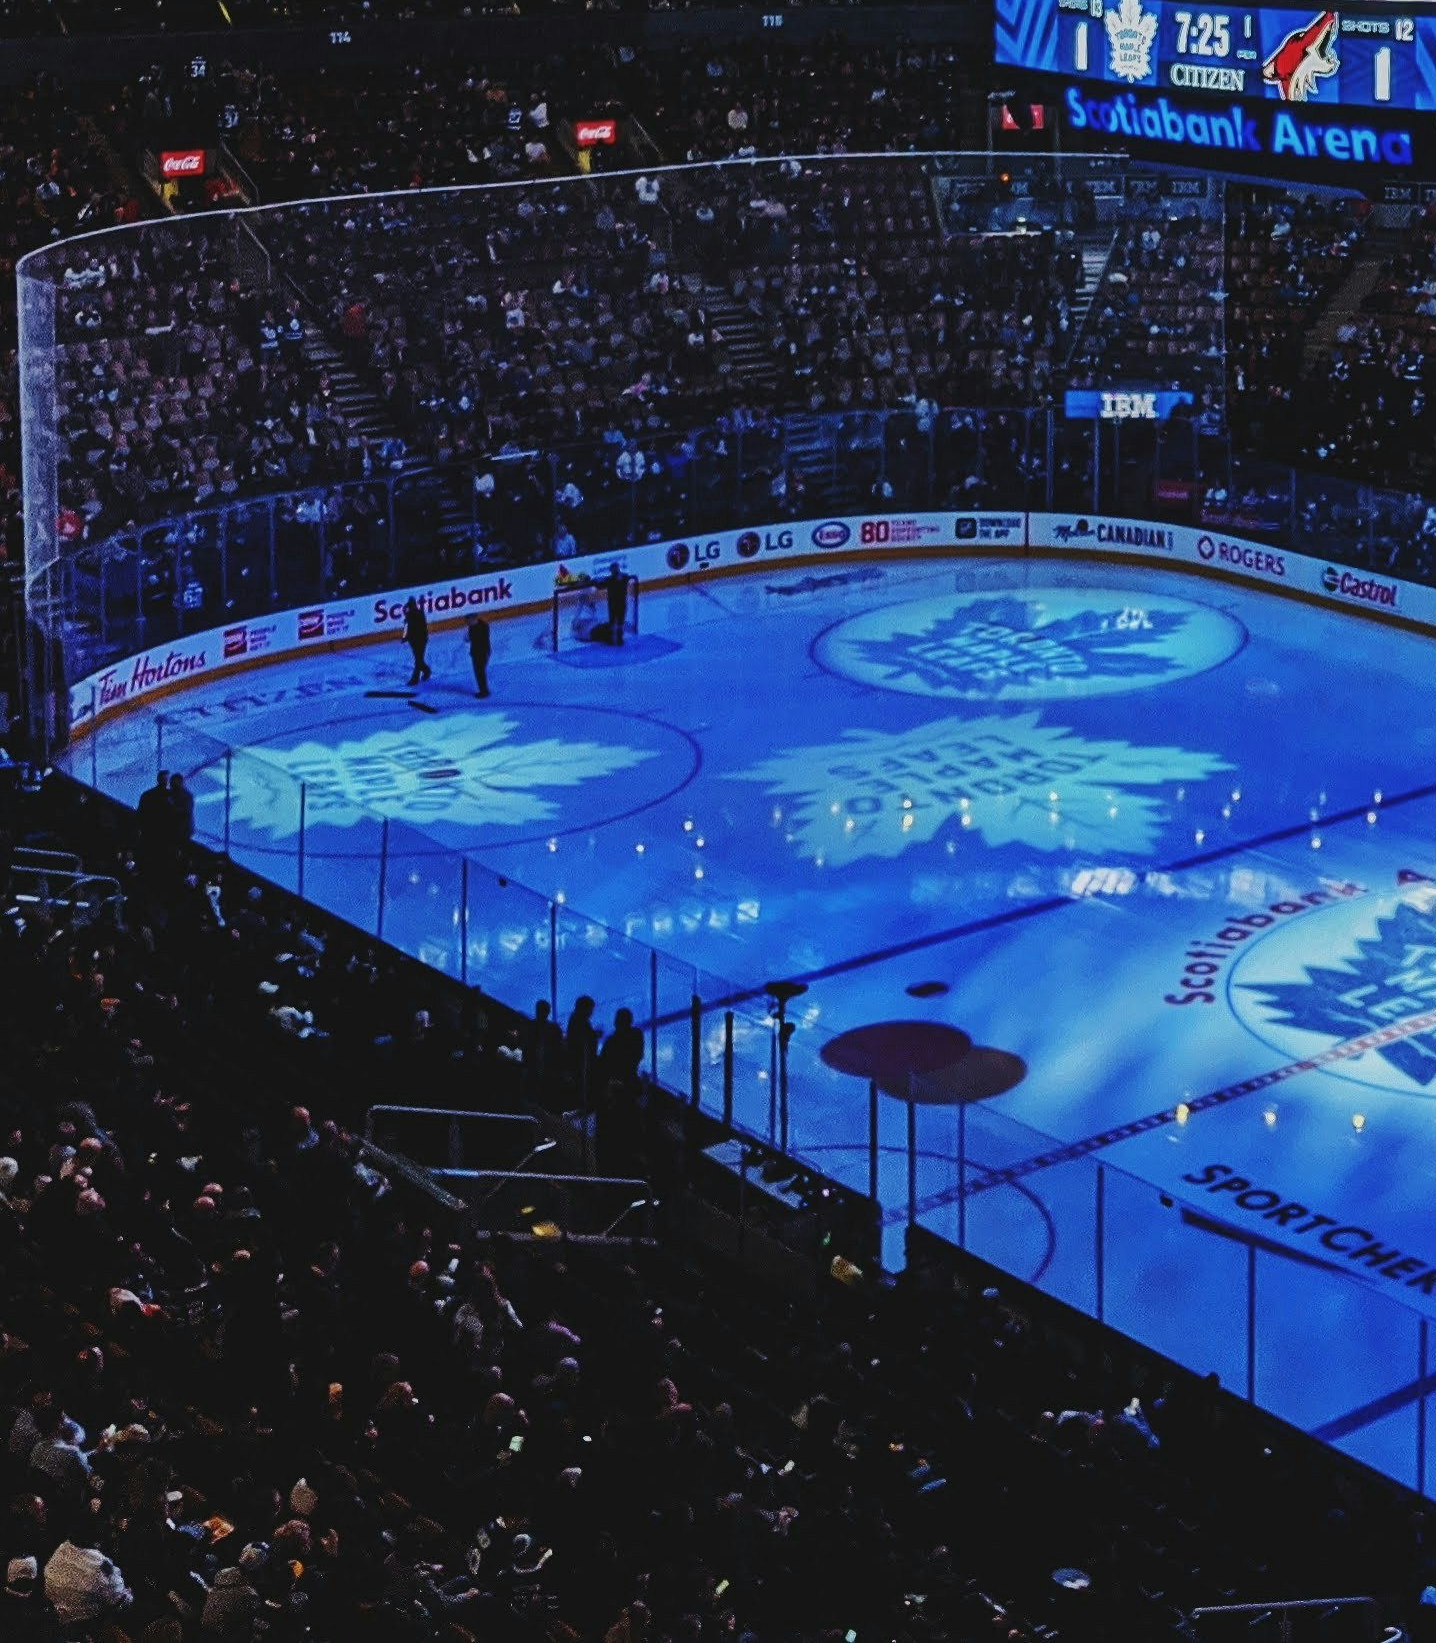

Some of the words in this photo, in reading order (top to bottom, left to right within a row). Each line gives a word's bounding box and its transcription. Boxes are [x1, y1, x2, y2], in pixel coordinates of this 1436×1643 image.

[1075, 21, 1089, 71] 1
[1175, 12, 1230, 58] 7:25
[1342, 20, 1390, 35] SHOTS
[1394, 18, 1414, 41] 12
[1170, 63, 1246, 92] CITIZEN
[1374, 47, 1391, 101] 1
[1062, 86, 1261, 153] Scotiabank
[1272, 111, 1414, 165] Arena
[1101, 392, 1160, 419] IBM
[765, 531, 793, 551] LG
[861, 521, 890, 543] 80
[1097, 524, 1165, 548] CANADIAN
[694, 541, 721, 562] LG
[1218, 541, 1286, 577] ROGERS
[1338, 570, 1398, 607] Castrol
[99, 668, 126, 707] Tim
[131, 651, 206, 693] Hortons
[1163, 877, 1369, 1006] Scotiabank
